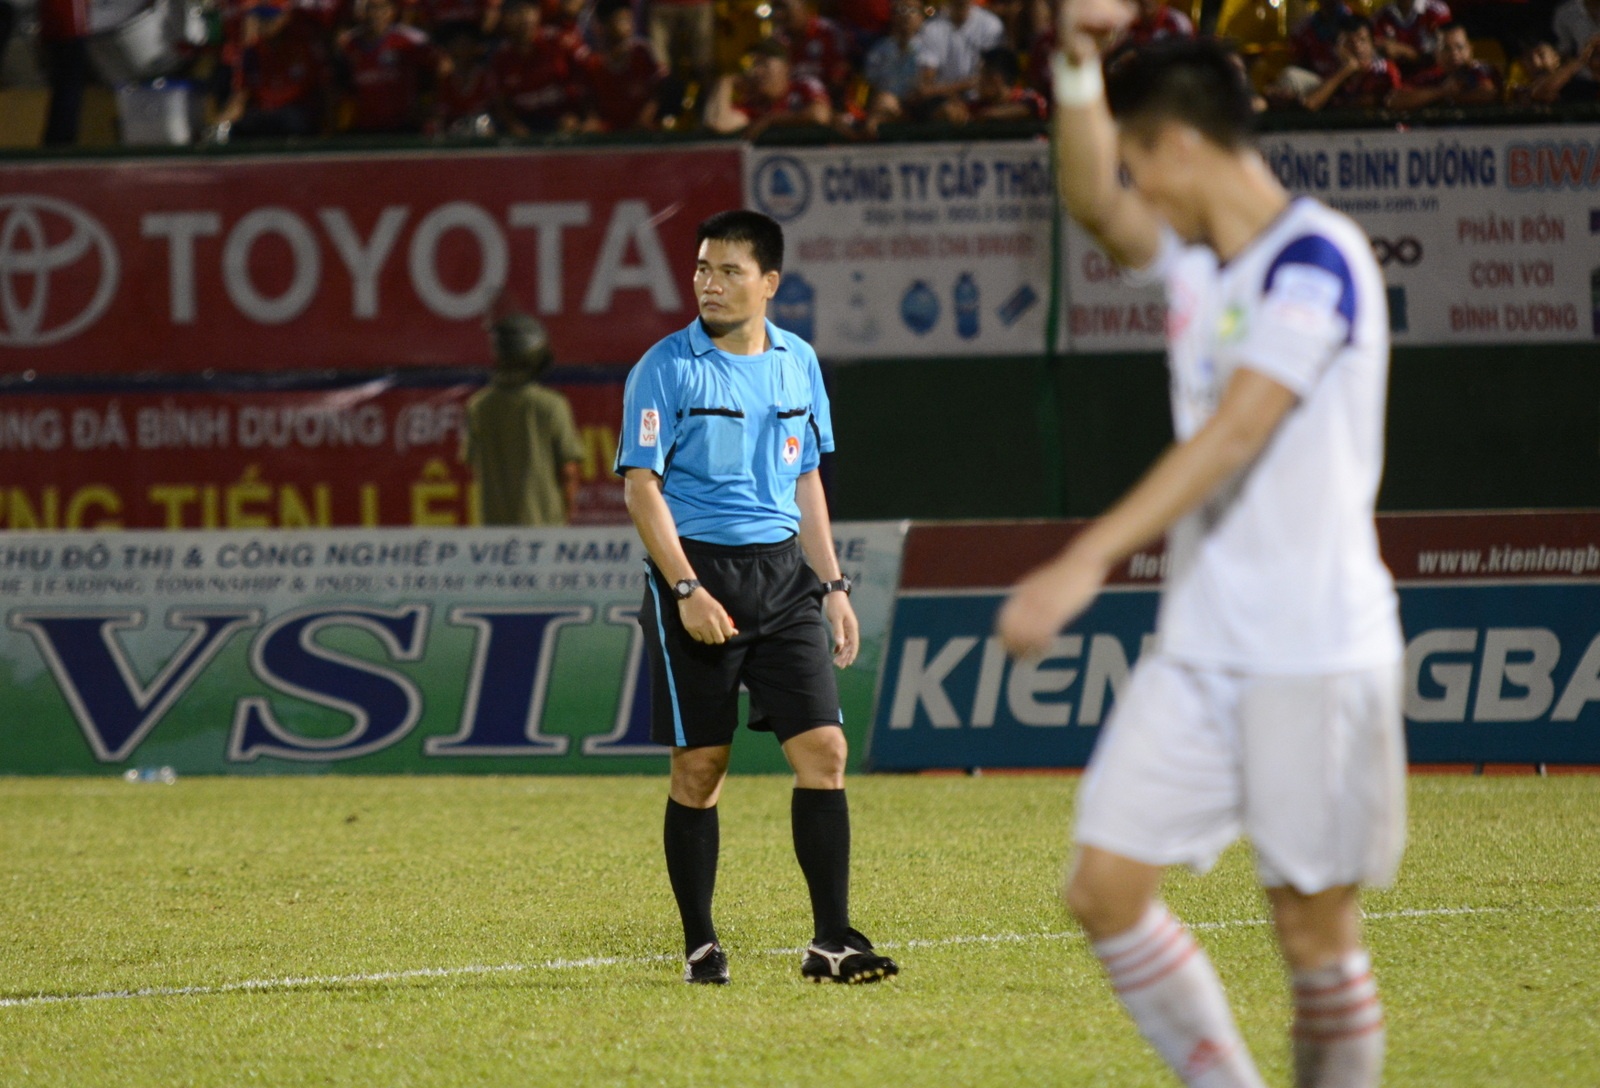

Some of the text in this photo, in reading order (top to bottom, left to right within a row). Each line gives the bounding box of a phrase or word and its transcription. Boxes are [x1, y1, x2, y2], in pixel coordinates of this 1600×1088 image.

[900, 162, 929, 199] TY
[1506, 142, 1600, 190] BIW
[142, 200, 682, 324] TOYOTA
[1469, 260, 1554, 288] CON VOI
[1069, 302, 1168, 336] BIWAS
[0, 409, 63, 449] NG
[0, 545, 52, 571] HU
[216, 537, 314, 568] CÔNG
[555, 540, 632, 564] NAM
